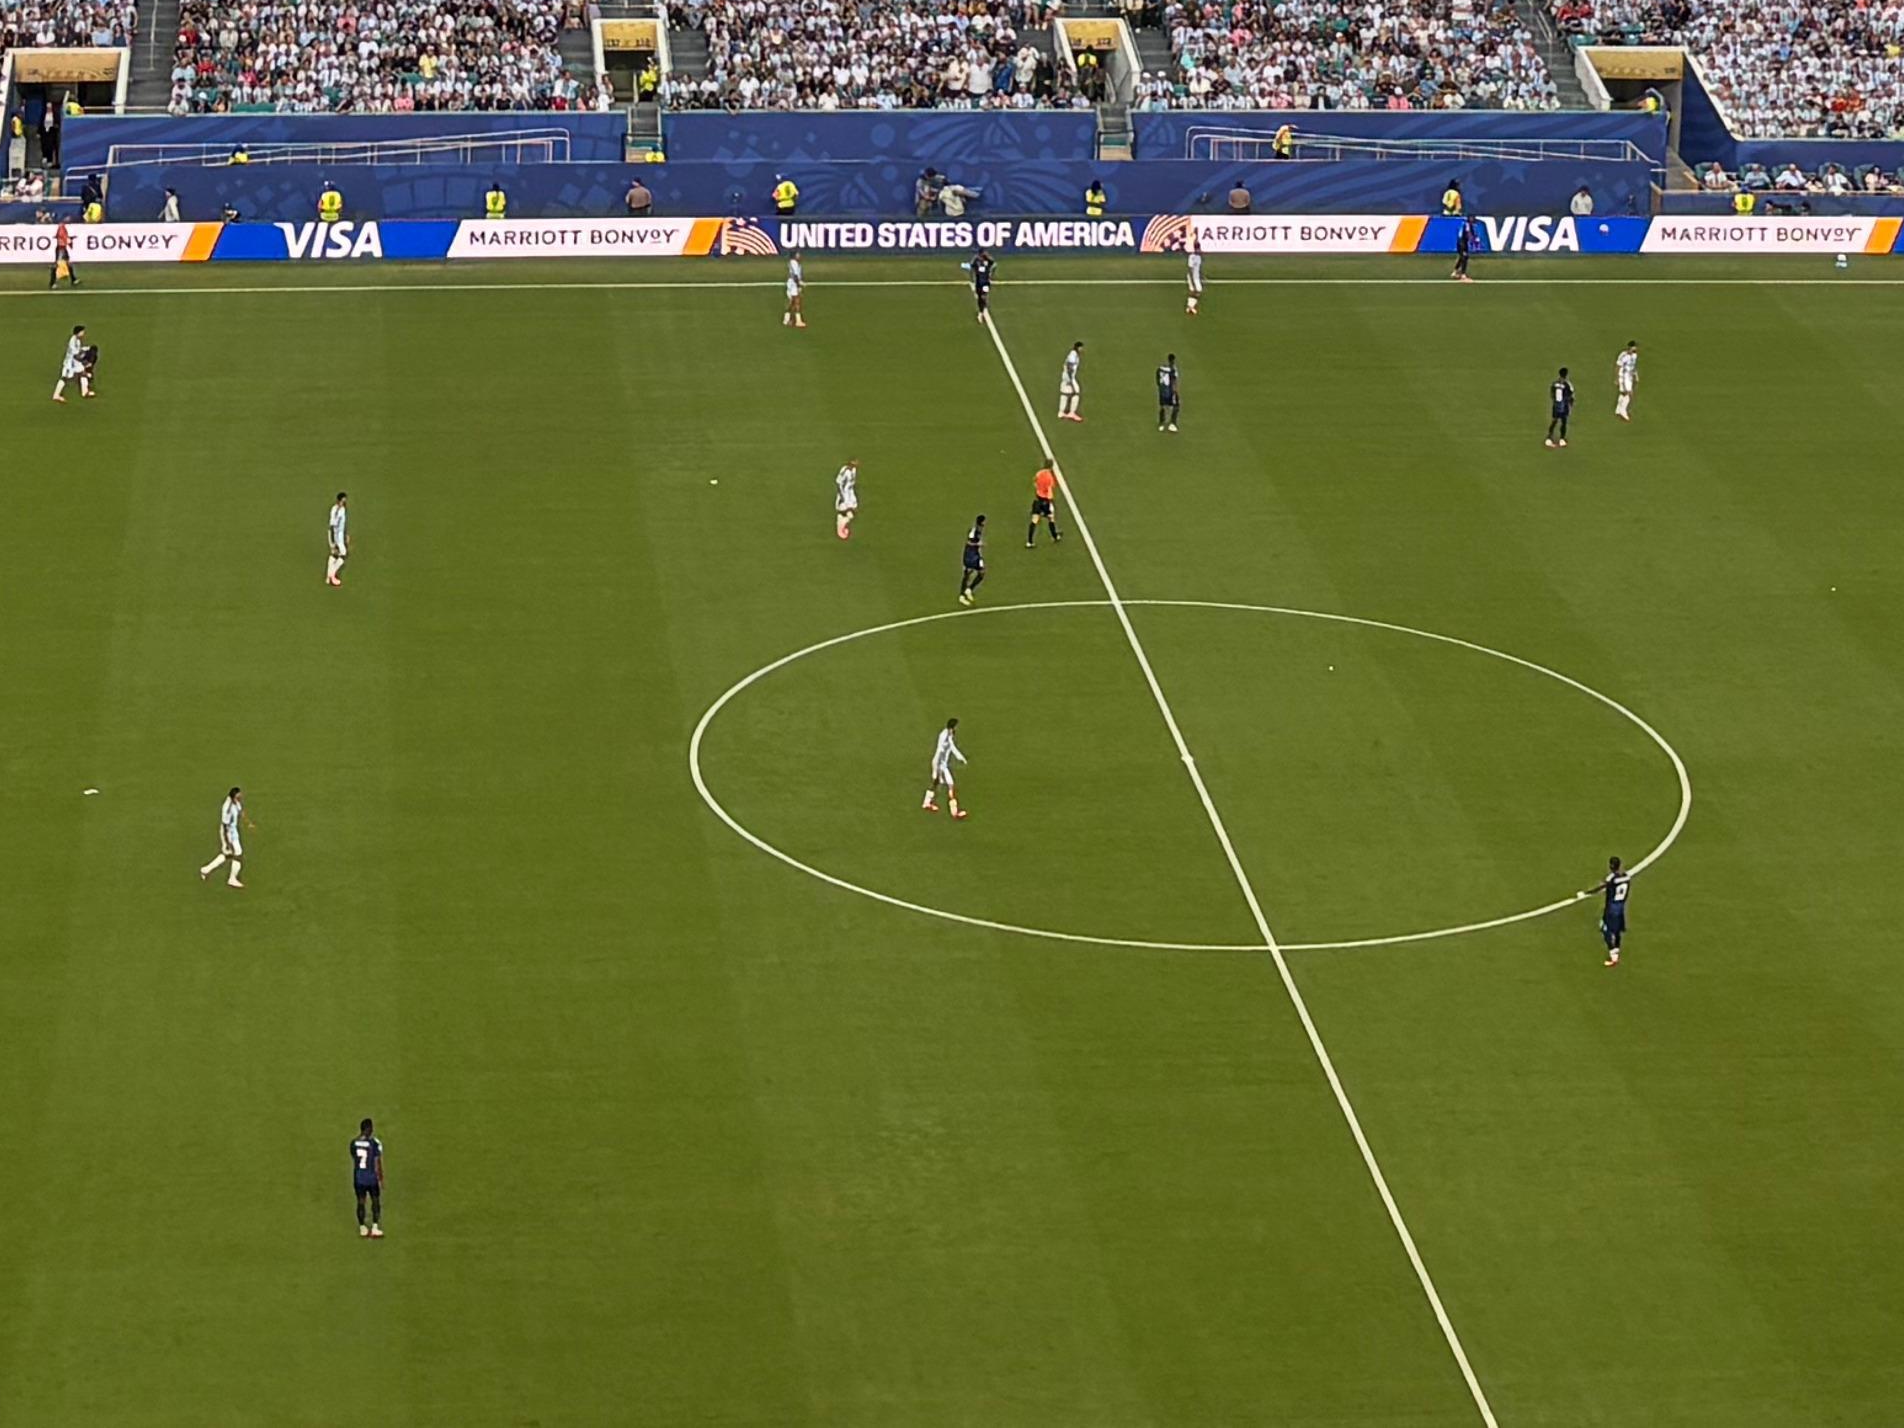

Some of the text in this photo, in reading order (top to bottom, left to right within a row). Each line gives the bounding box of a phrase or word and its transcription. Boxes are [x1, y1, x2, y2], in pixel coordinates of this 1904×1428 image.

[275, 221, 384, 260] VISA
[469, 229, 583, 247] MARRIOTT
[780, 220, 1135, 250] UNITED STATES OF AMERICA
[1487, 216, 1580, 253] VISA
[1661, 226, 1767, 243] MARRIOTT
